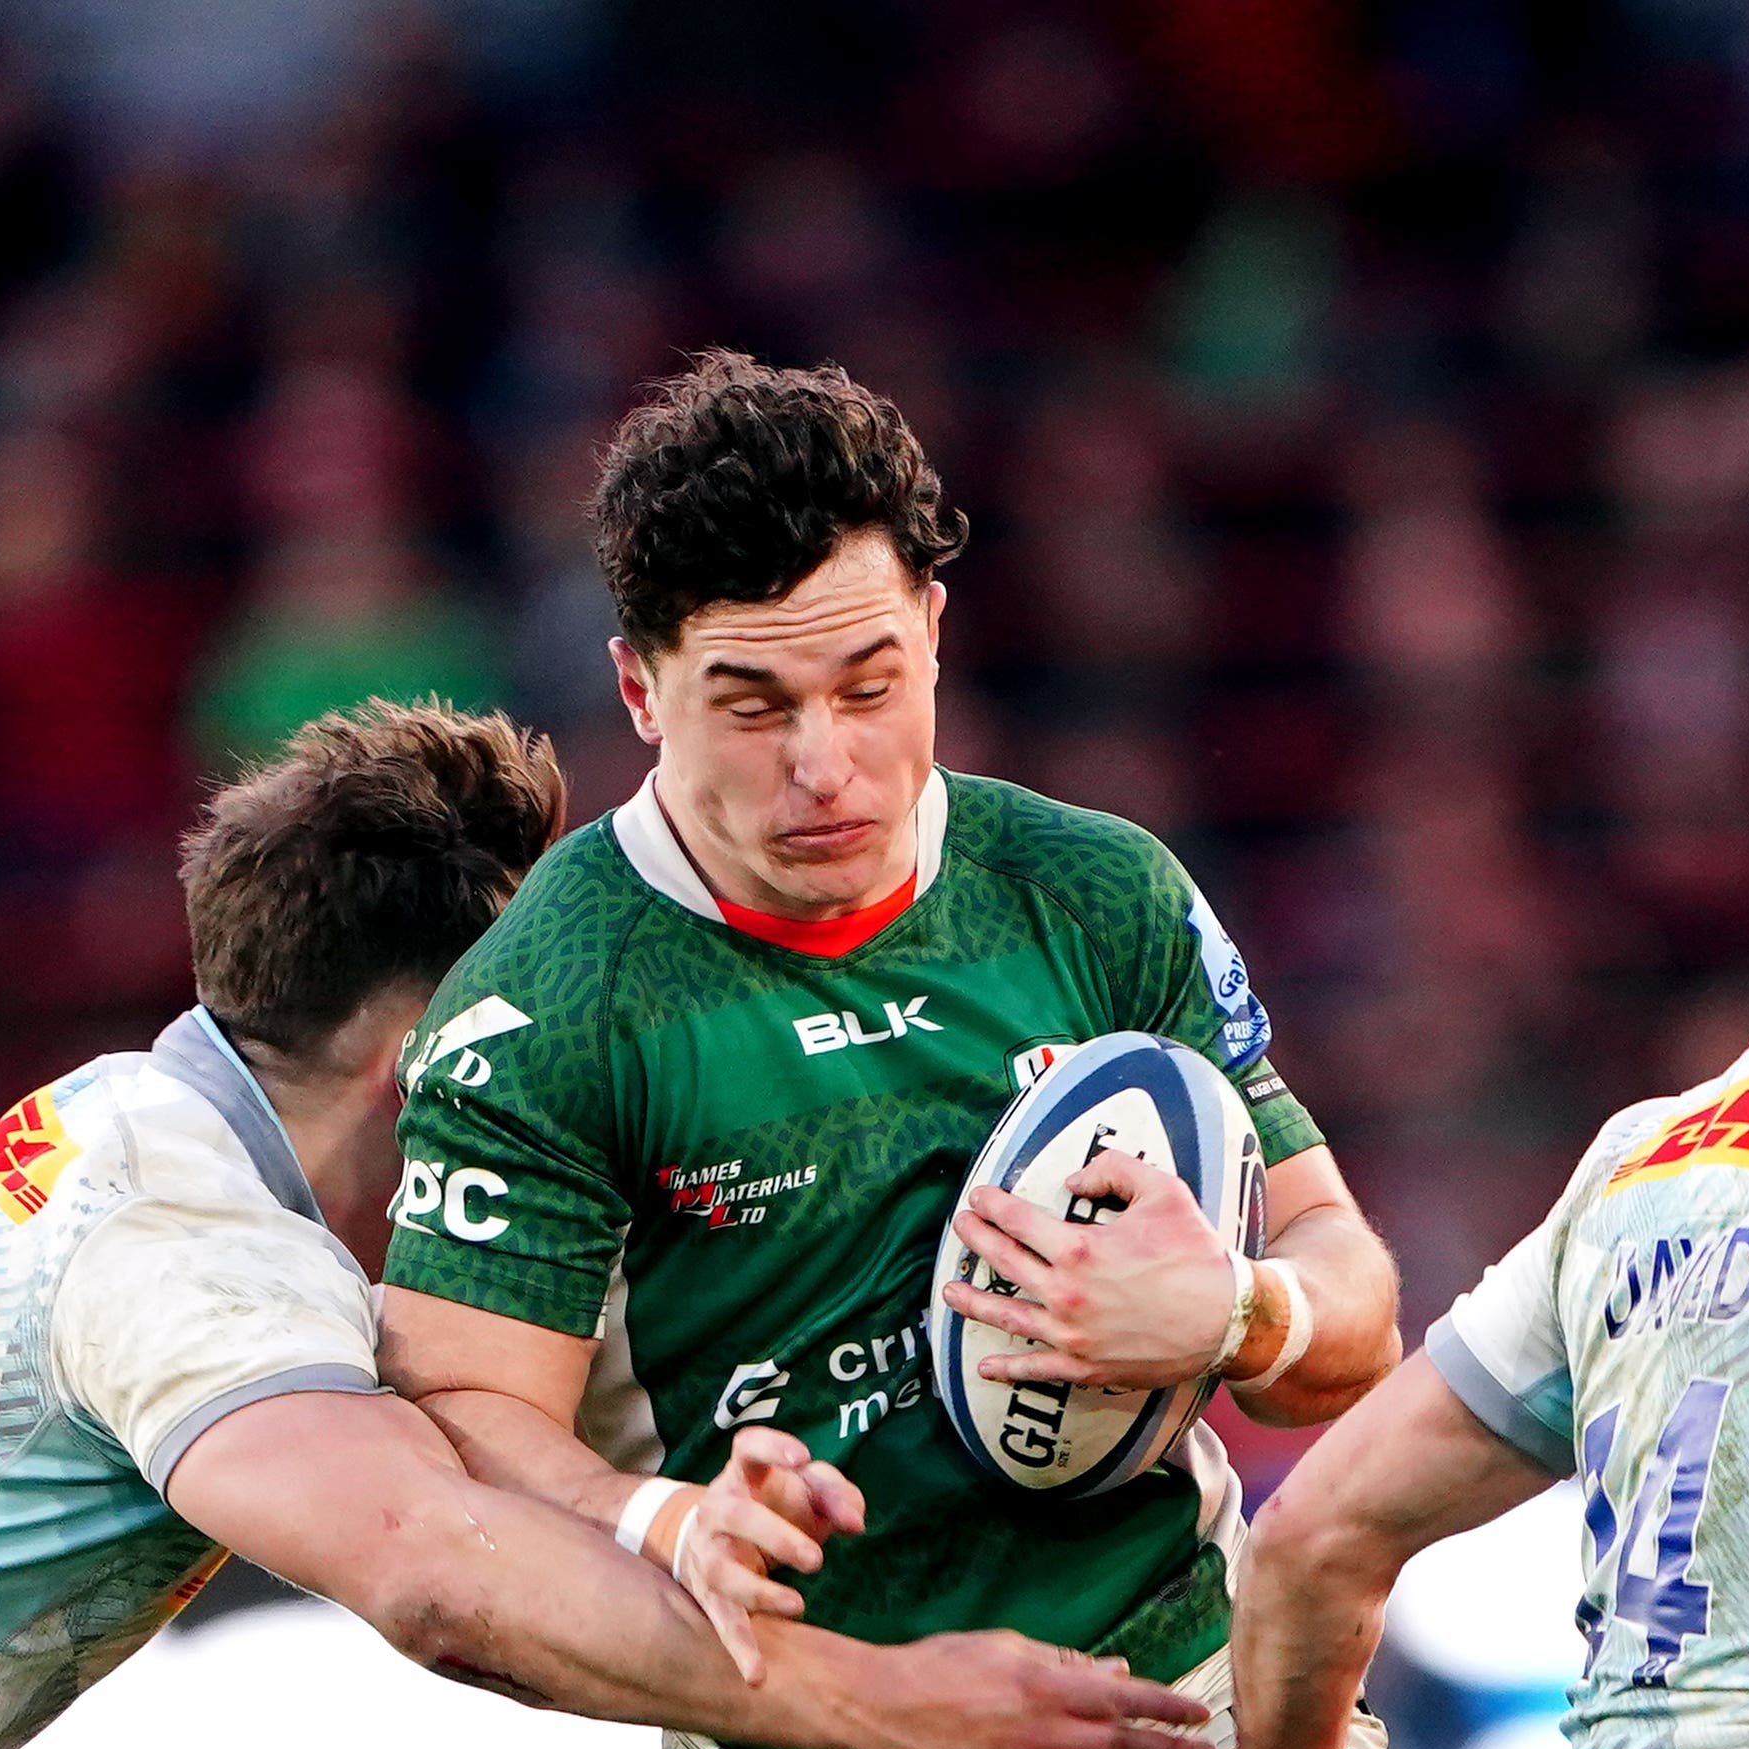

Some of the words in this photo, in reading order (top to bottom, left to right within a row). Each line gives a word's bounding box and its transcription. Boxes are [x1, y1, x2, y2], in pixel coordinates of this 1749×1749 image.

[792, 995, 945, 1056] BLK
[656, 1158, 744, 1190] THAMES
[669, 1164, 818, 1217] MATERIALS
[707, 1204, 767, 1230] LTD
[1576, 1377, 1733, 1688] 14
